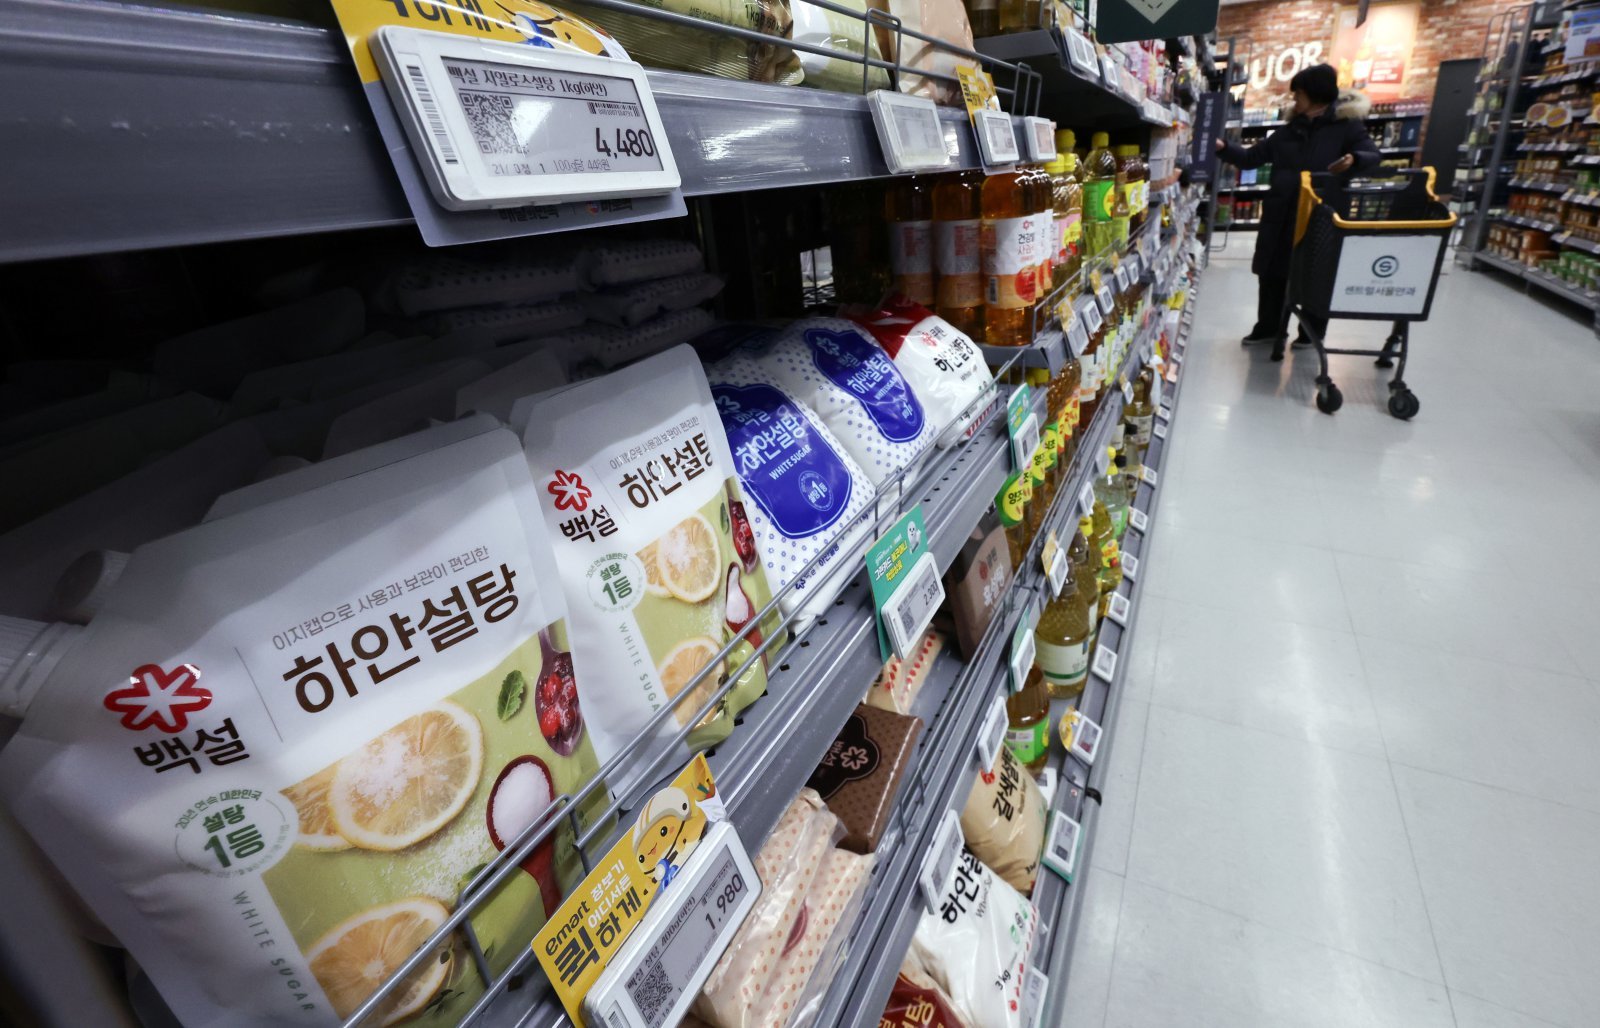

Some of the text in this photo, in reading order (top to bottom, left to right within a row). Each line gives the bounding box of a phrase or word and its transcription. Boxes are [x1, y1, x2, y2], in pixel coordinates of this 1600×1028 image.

[846, 353, 893, 395] 하얀설탕
[735, 413, 806, 470] 하얀설탕
[769, 444, 812, 480] WHITE SUGAR
[559, 504, 618, 543] 백설
[600, 562, 621, 581] 설탕
[602, 576, 633, 605] 1등
[272, 545, 490, 651] 이지캡으로 사용과 보관이 편리한
[282, 563, 519, 713] 하얀설탕
[618, 621, 642, 668] WHITE
[134, 717, 250, 774] 백설
[175, 789, 263, 830] 20년 연속 대한민국
[202, 804, 246, 834] 설탕
[204, 823, 265, 868] 1등
[587, 873, 632, 929] 어디서든
[590, 858, 625, 902] 장보기
[232, 889, 275, 949] WHITE
[271, 957, 316, 1012] SUGAR
[545, 901, 590, 956] emart
